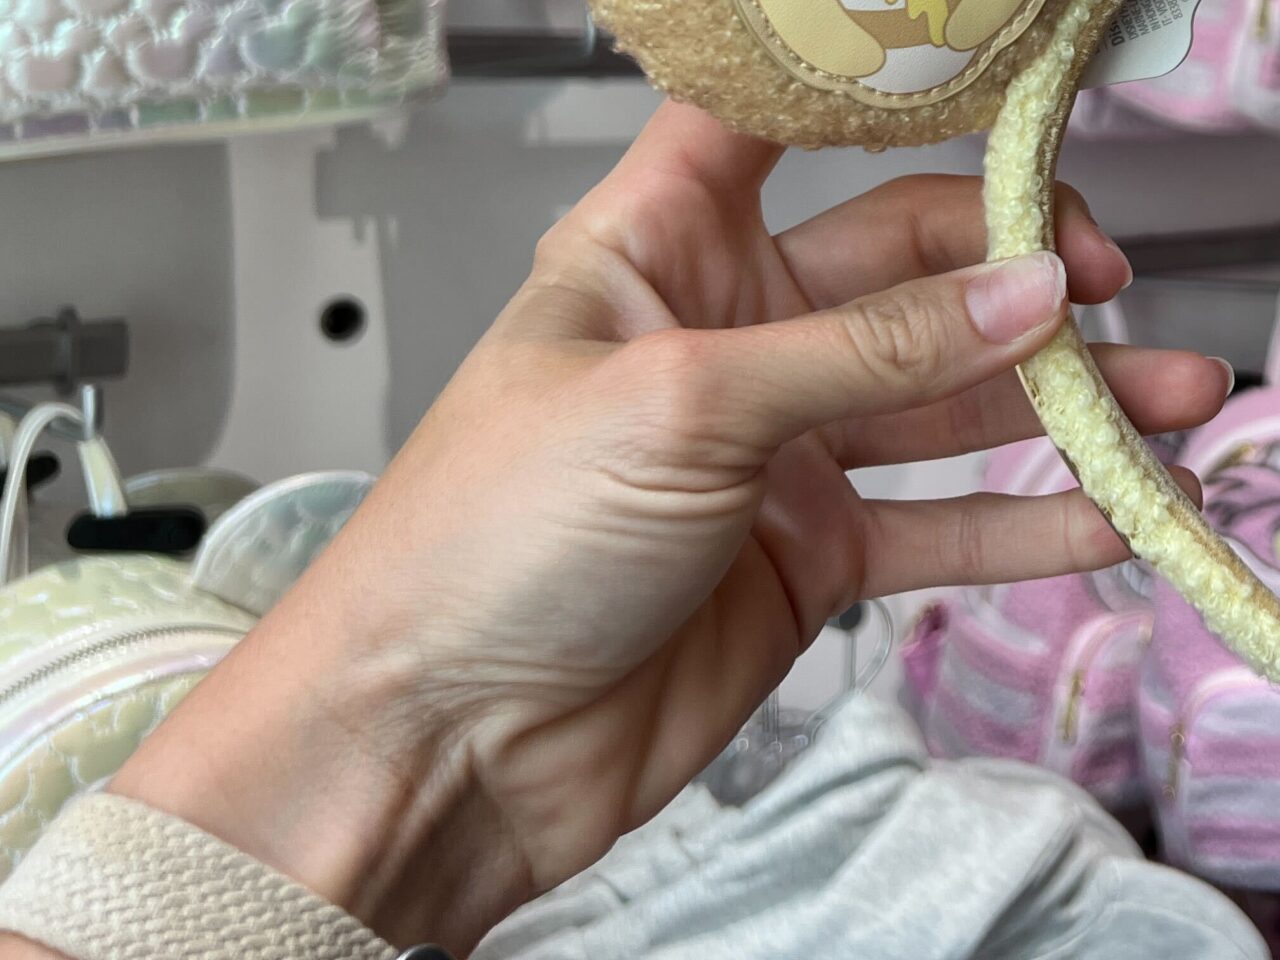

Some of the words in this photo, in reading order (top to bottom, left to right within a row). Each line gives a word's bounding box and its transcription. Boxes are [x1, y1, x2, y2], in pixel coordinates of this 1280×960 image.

[1141, 0, 1158, 23] HONG
[1150, 21, 1161, 31] IN
[1161, 18, 1173, 26] IT
